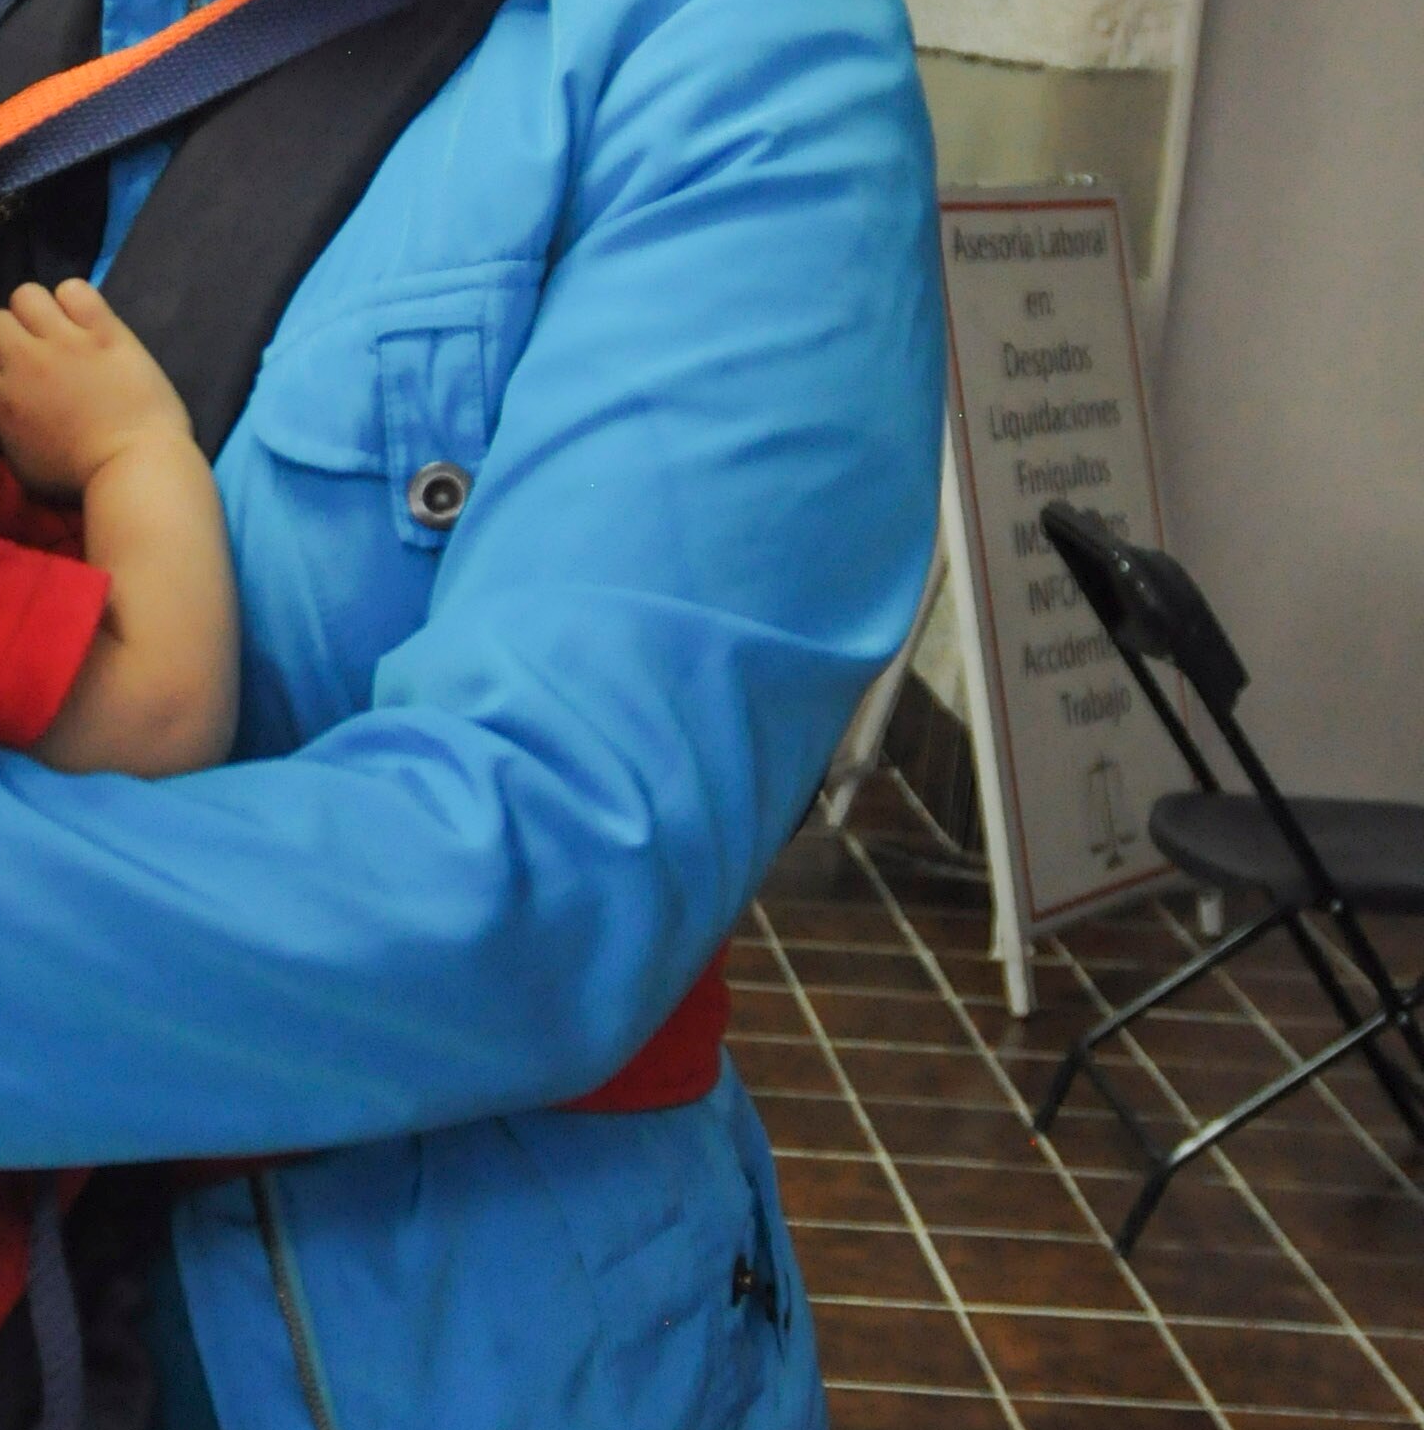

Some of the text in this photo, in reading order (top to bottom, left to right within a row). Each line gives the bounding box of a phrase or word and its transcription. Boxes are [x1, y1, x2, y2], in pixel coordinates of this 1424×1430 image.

[1038, 223, 1107, 259] Laboral
[1001, 340, 1093, 382] Despidos
[989, 397, 1123, 445] Liquidaciones
[1014, 456, 1113, 499] Finiquitos
[1060, 681, 1132, 728] Trabajo
